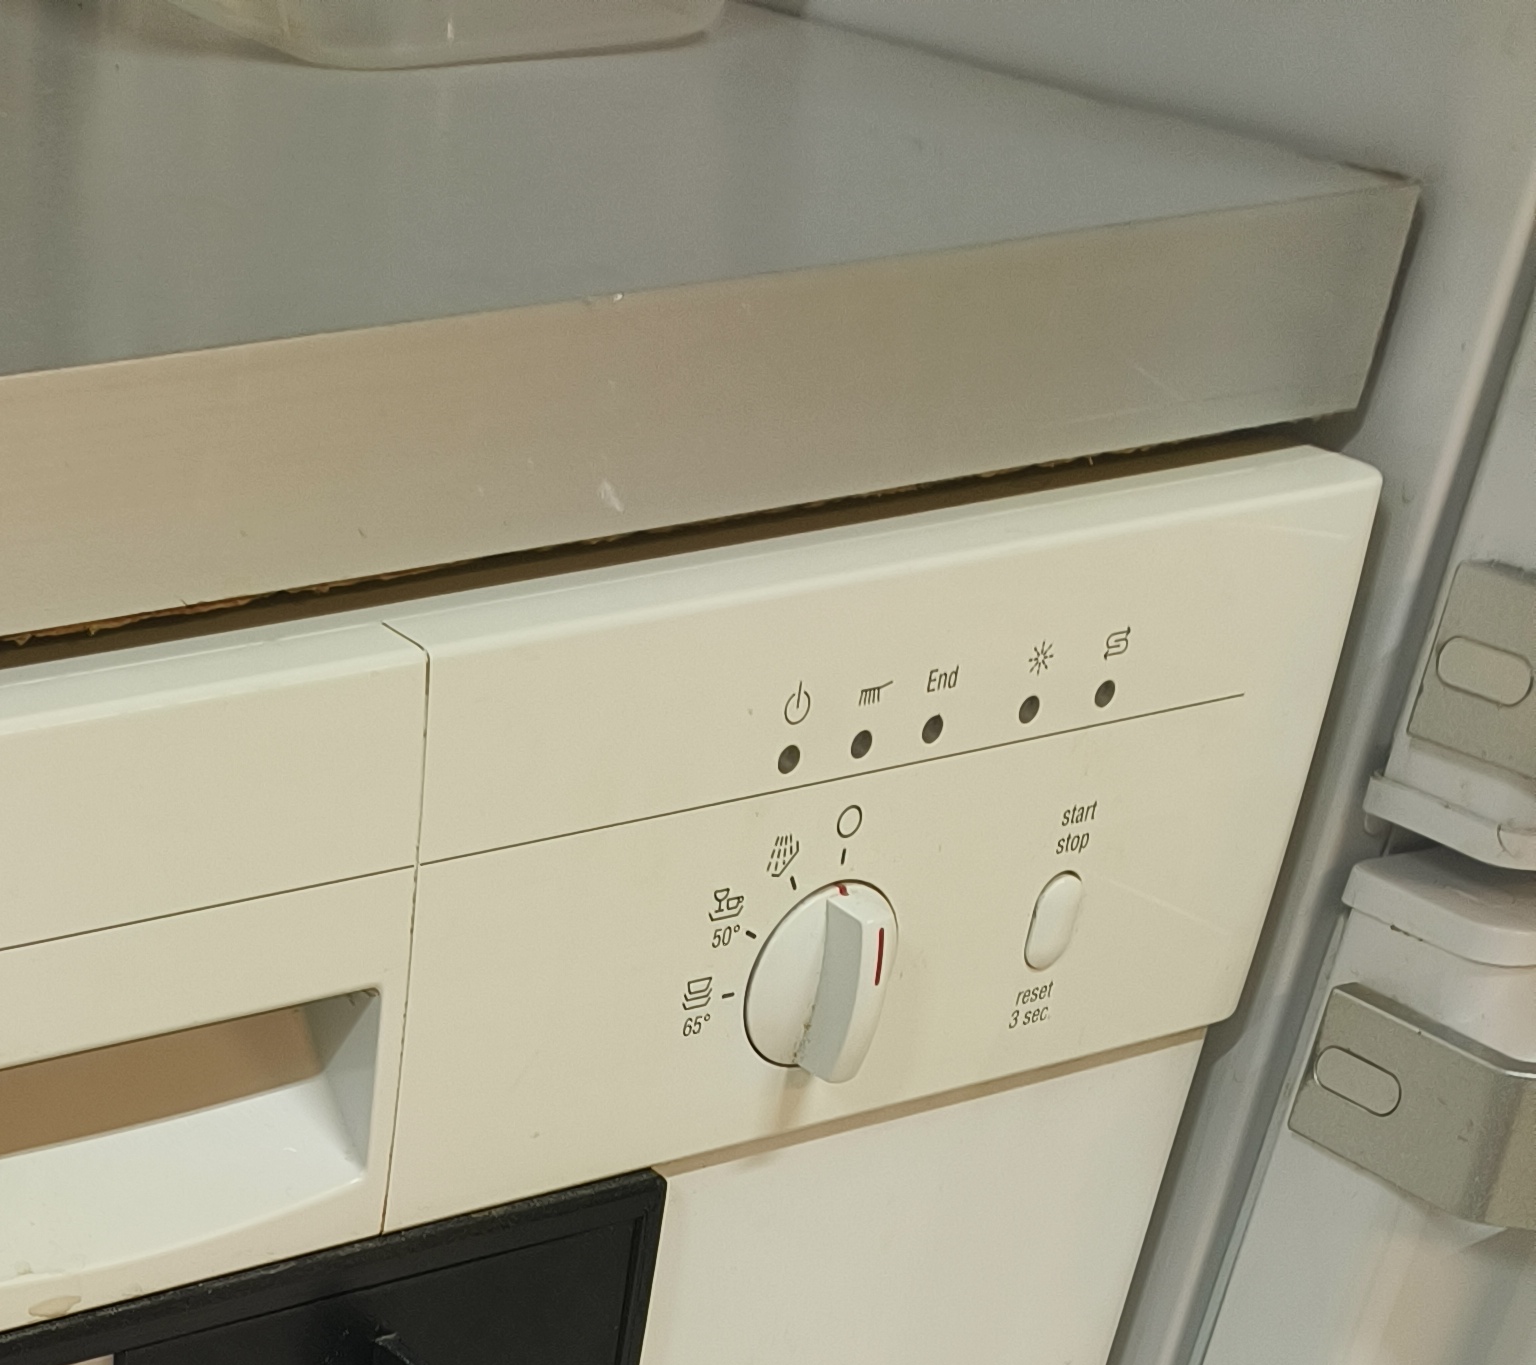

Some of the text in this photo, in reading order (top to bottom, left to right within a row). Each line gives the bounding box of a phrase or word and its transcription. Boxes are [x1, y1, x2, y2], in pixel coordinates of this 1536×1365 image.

[926, 664, 960, 693] End
[1061, 800, 1098, 827] start
[1055, 832, 1090, 855] stop
[711, 924, 741, 949] 50°
[1015, 980, 1054, 1006] reset
[682, 1013, 711, 1037] 65°
[1008, 1009, 1020, 1029] 3
